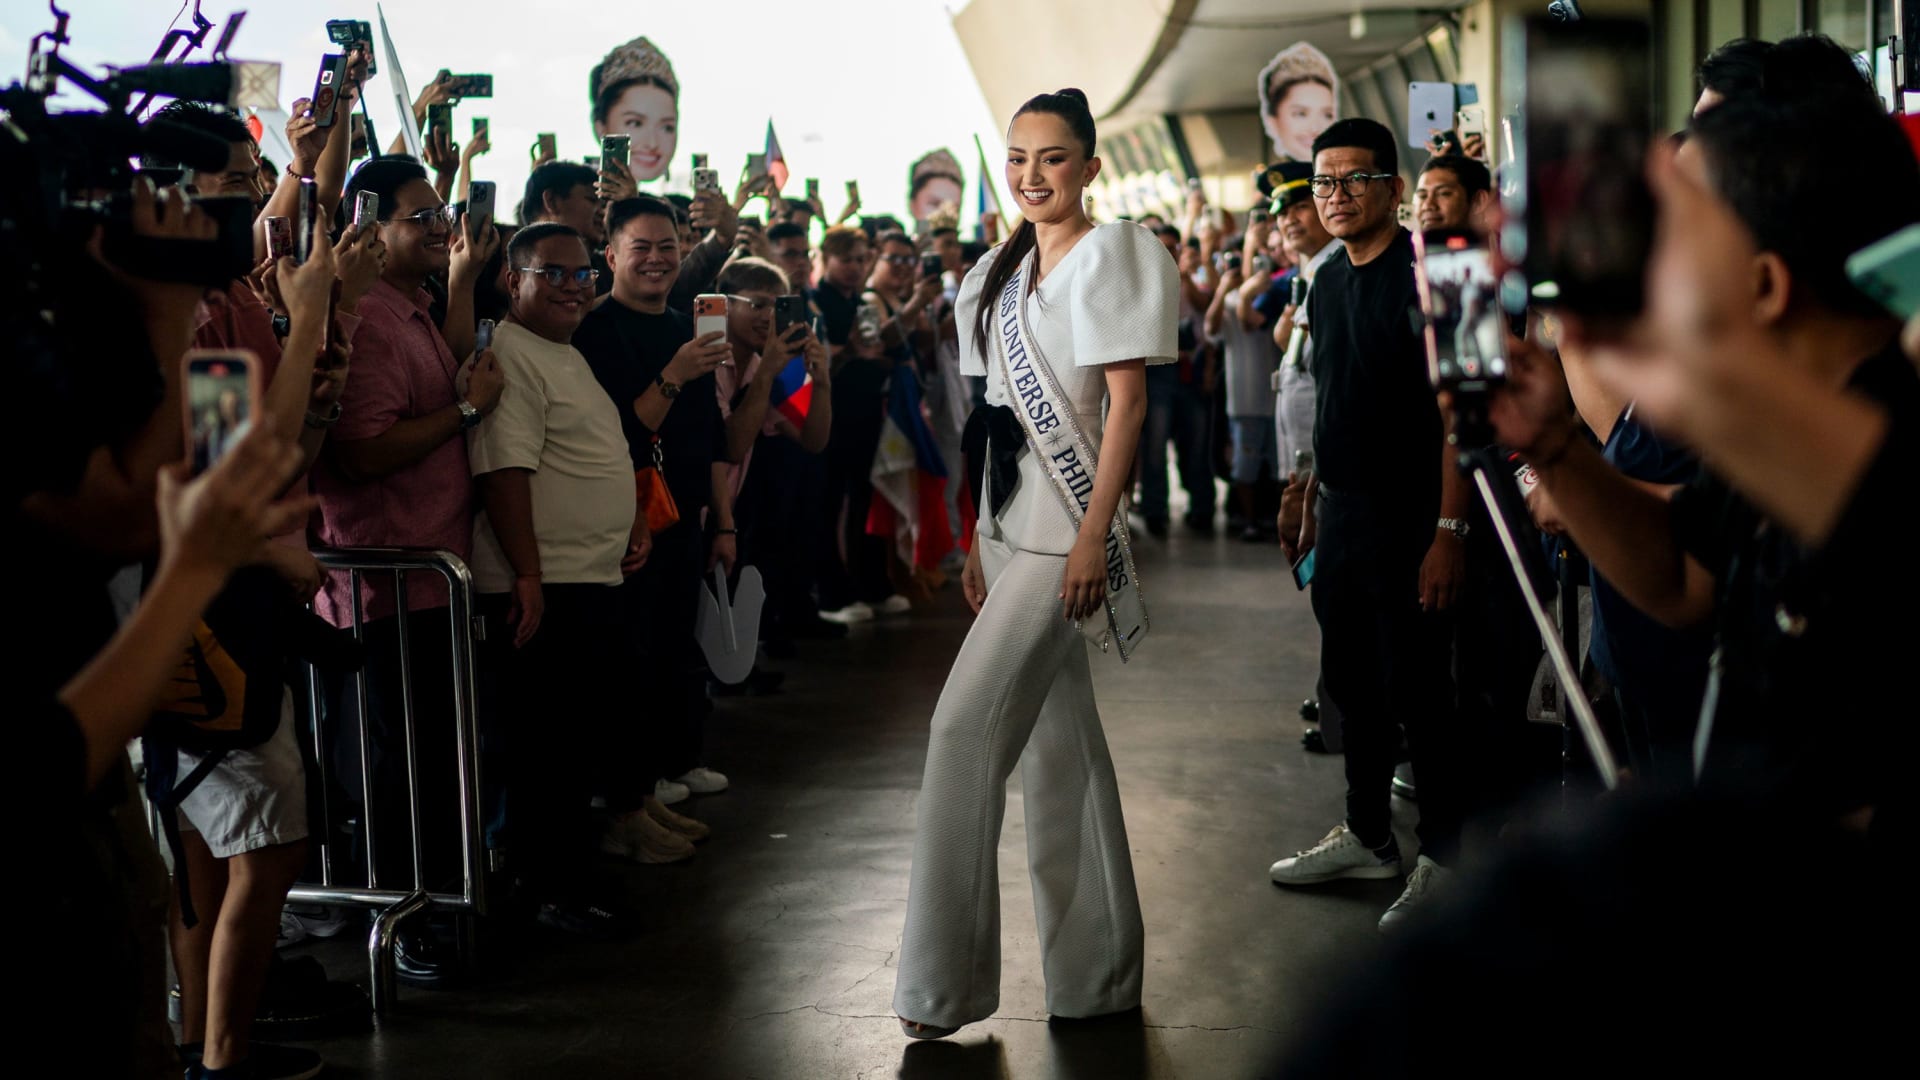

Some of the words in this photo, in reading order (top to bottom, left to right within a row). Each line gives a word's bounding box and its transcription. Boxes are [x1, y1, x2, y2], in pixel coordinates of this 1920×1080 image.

[1001, 268, 1022, 318] MISS
[1003, 314, 1061, 435] UNIVERSE
[1051, 445, 1129, 593] PHILINES
